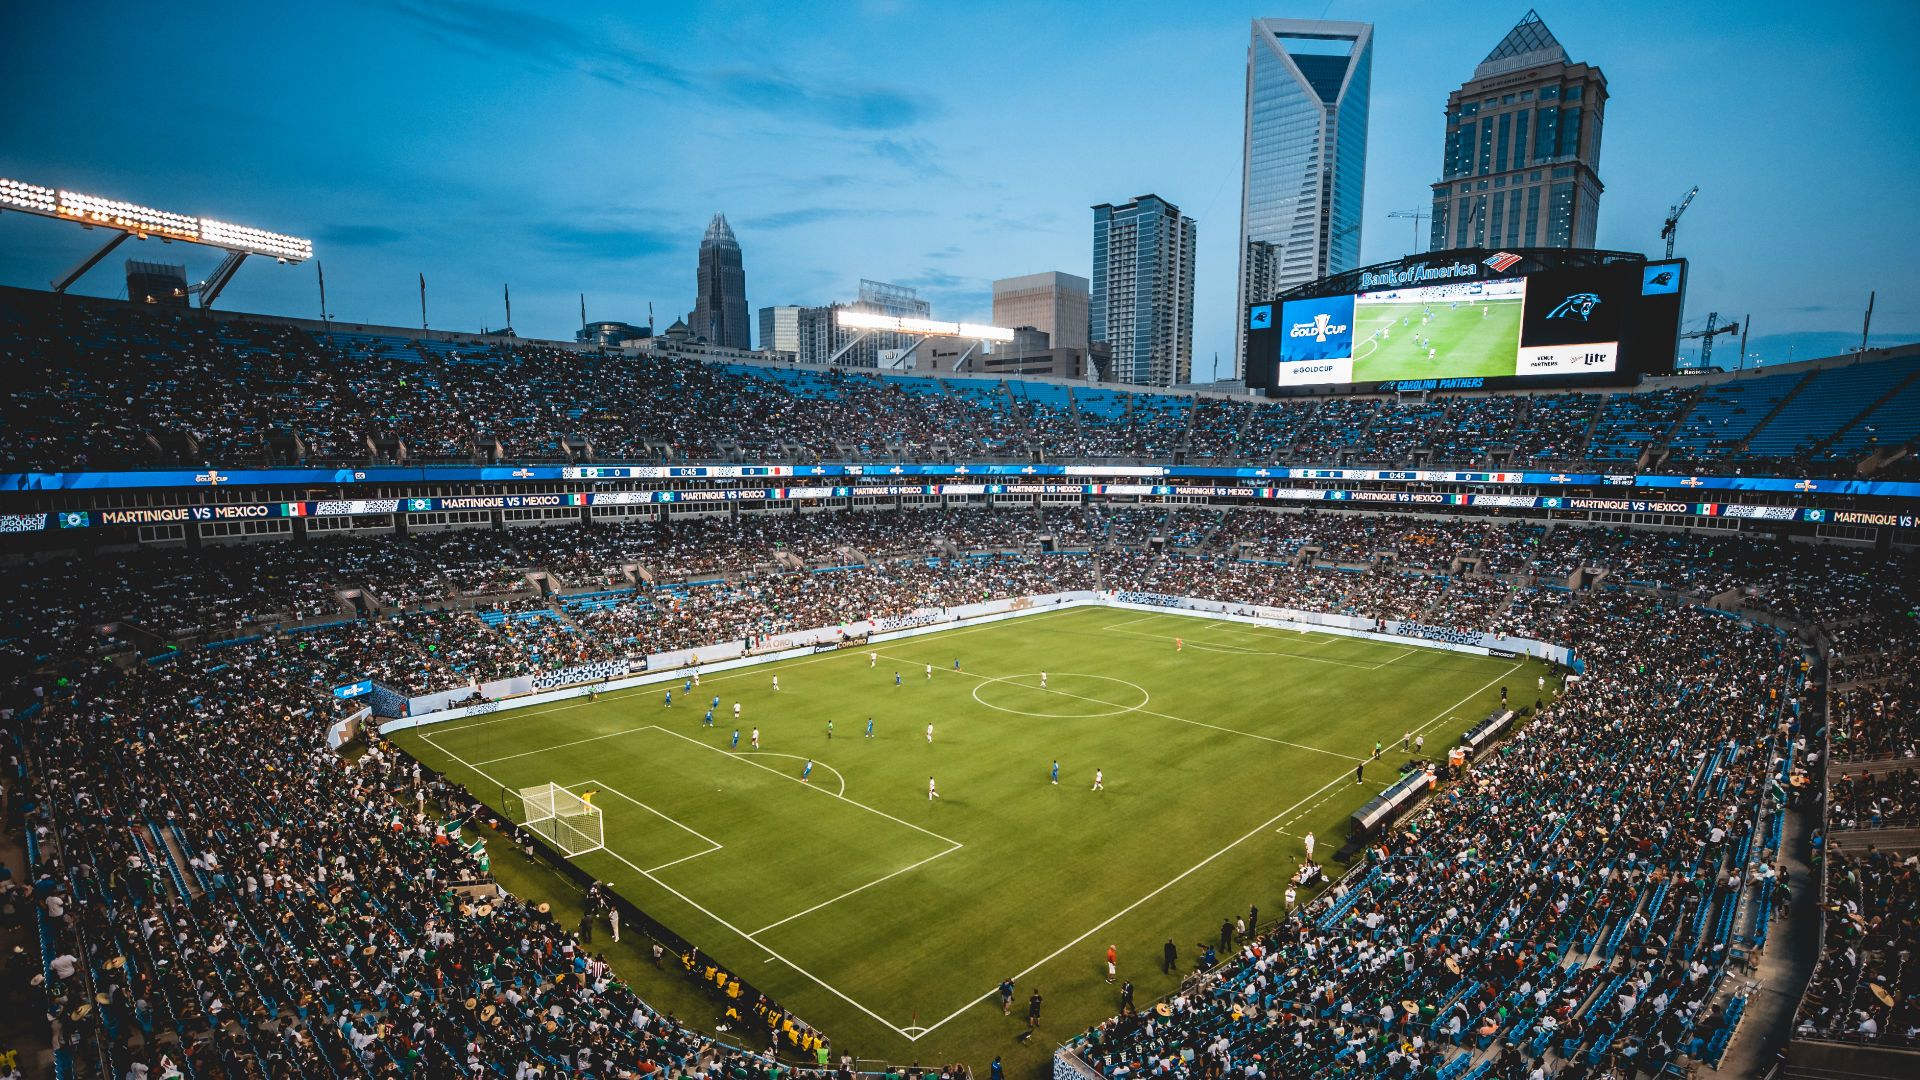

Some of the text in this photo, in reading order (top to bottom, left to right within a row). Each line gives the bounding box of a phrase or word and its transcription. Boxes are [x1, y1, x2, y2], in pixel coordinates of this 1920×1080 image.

[1362, 262, 1477, 286] Bank of America
[1290, 327, 1318, 338] GOLD
[1325, 325, 1347, 335] CUP
[1584, 353, 1607, 366] Lite
[1397, 378, 1484, 391] CAROLINA PANTHERS
[680, 468, 697, 476] 0:45
[681, 490, 766, 500] MARTINIQUE VS MEXICO
[1176, 487, 1254, 496] MARTINIQUE VS MEXICO
[1351, 492, 1443, 503] MARTINIQUE VS MEXICO
[441, 496, 560, 509] MARTINIQUE VS MEXICO
[1570, 499, 1687, 513] MARTINIQUE VS MEXICO
[102, 505, 268, 524] MARTINIQUE VS MEXICO
[1833, 511, 1898, 526] MARTINIQUE
[1899, 515, 1912, 527] VS
